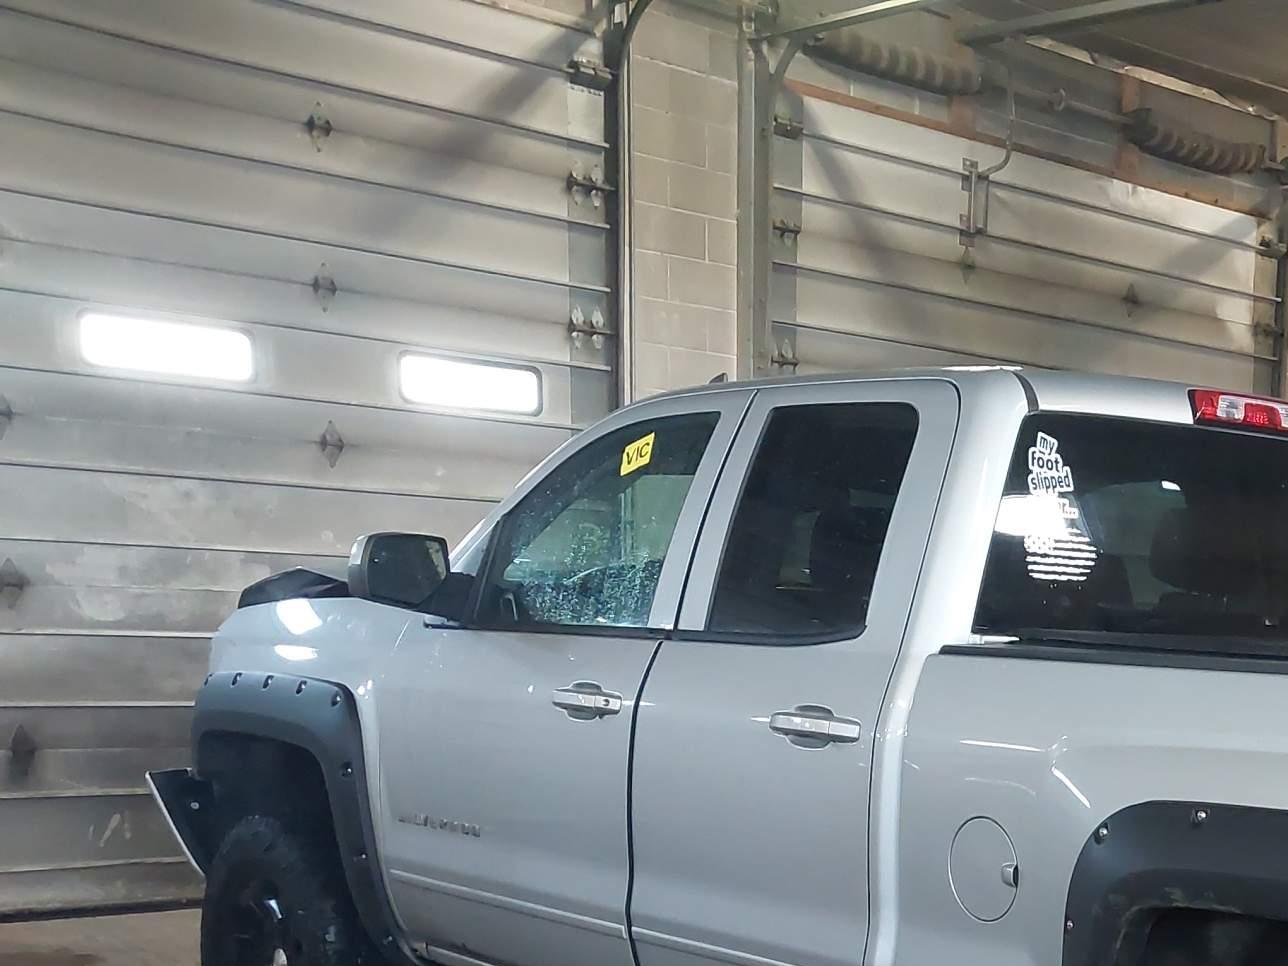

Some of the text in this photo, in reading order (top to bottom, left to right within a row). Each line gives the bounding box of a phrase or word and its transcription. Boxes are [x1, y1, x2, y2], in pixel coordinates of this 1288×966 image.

[626, 442, 650, 465] VIC
[1040, 436, 1056, 455] my
[1031, 468, 1071, 494] slipped
